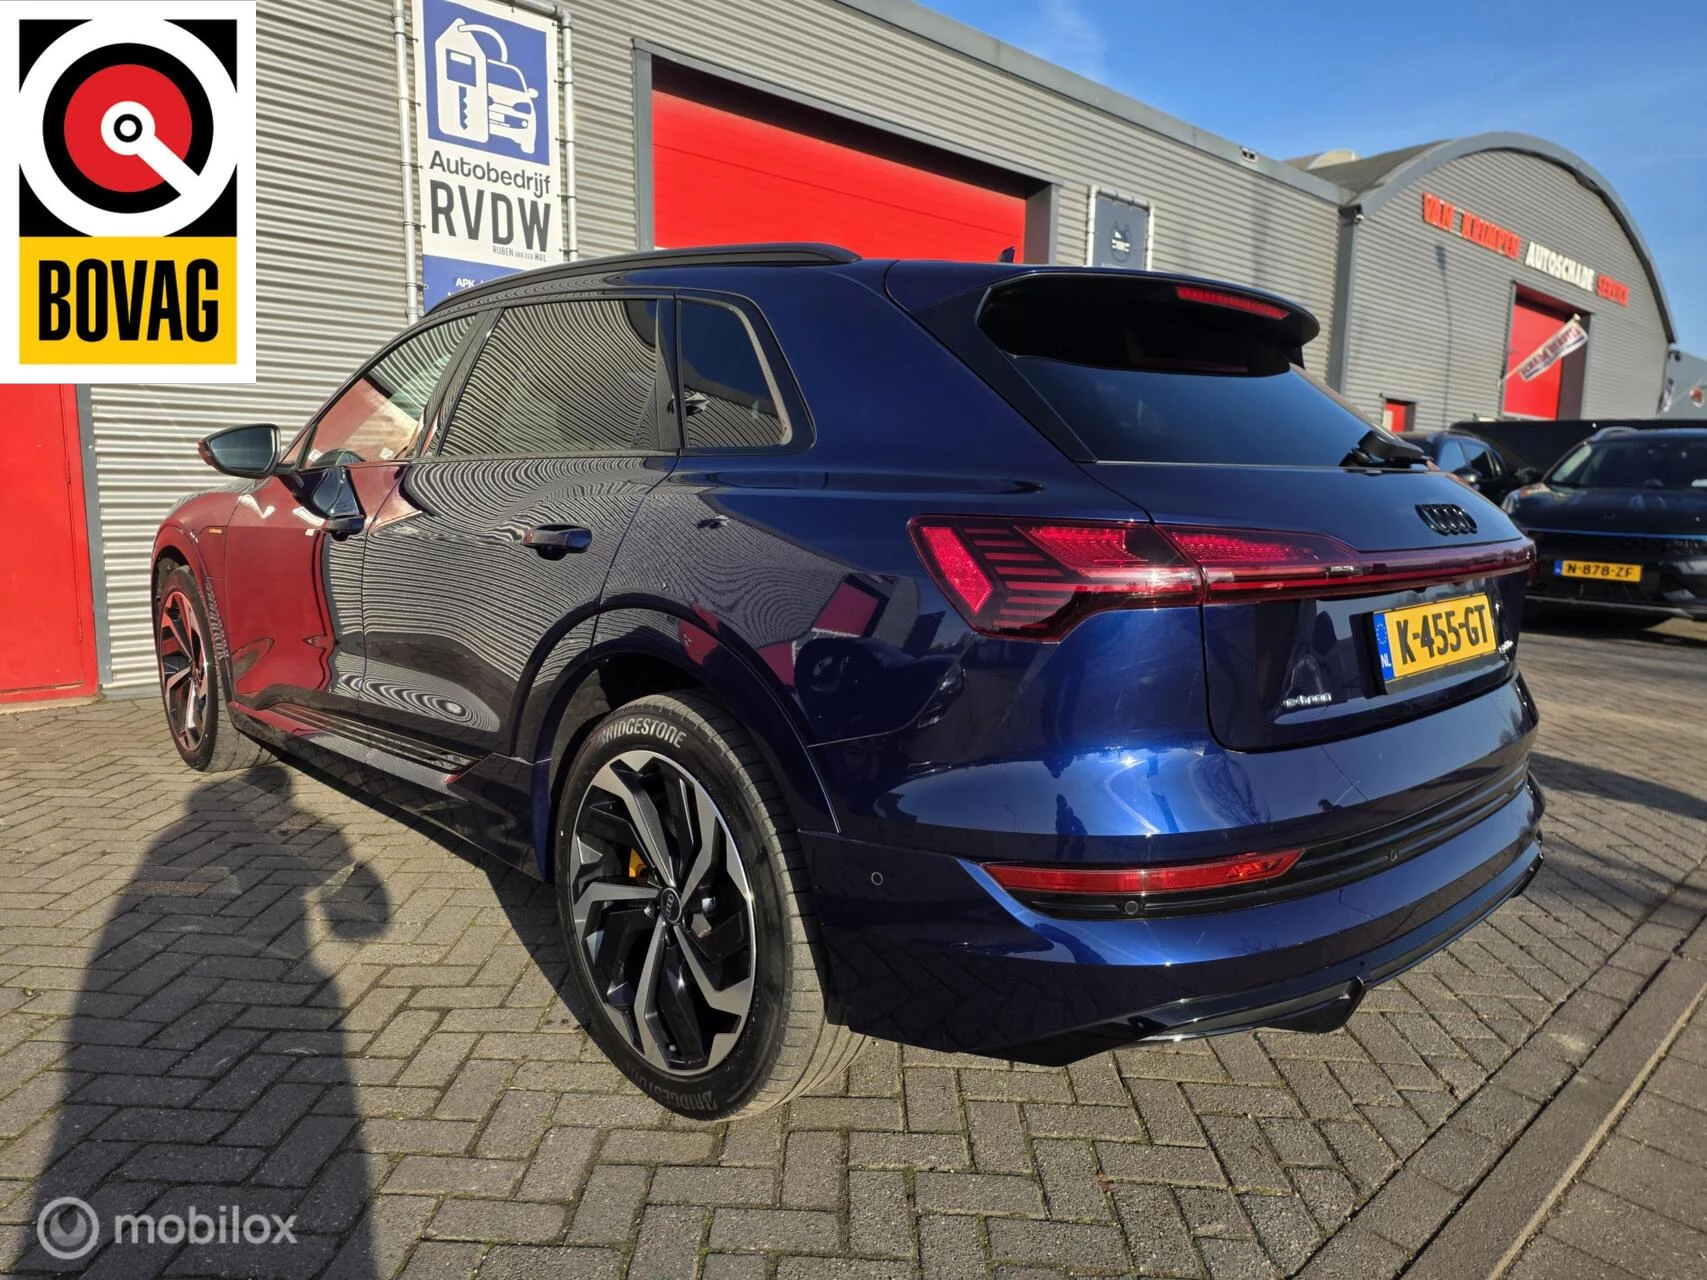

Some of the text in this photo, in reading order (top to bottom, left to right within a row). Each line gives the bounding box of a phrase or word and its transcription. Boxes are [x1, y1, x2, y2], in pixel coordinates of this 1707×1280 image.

[429, 150, 551, 199] Autobedrijf
[430, 179, 551, 253] RVDW
[1567, 562, 1635, 579] N-878-ZF
[1396, 604, 1489, 666] K-455-GT
[1381, 652, 1392, 668] NL
[600, 717, 688, 750] BRIDGESTONE
